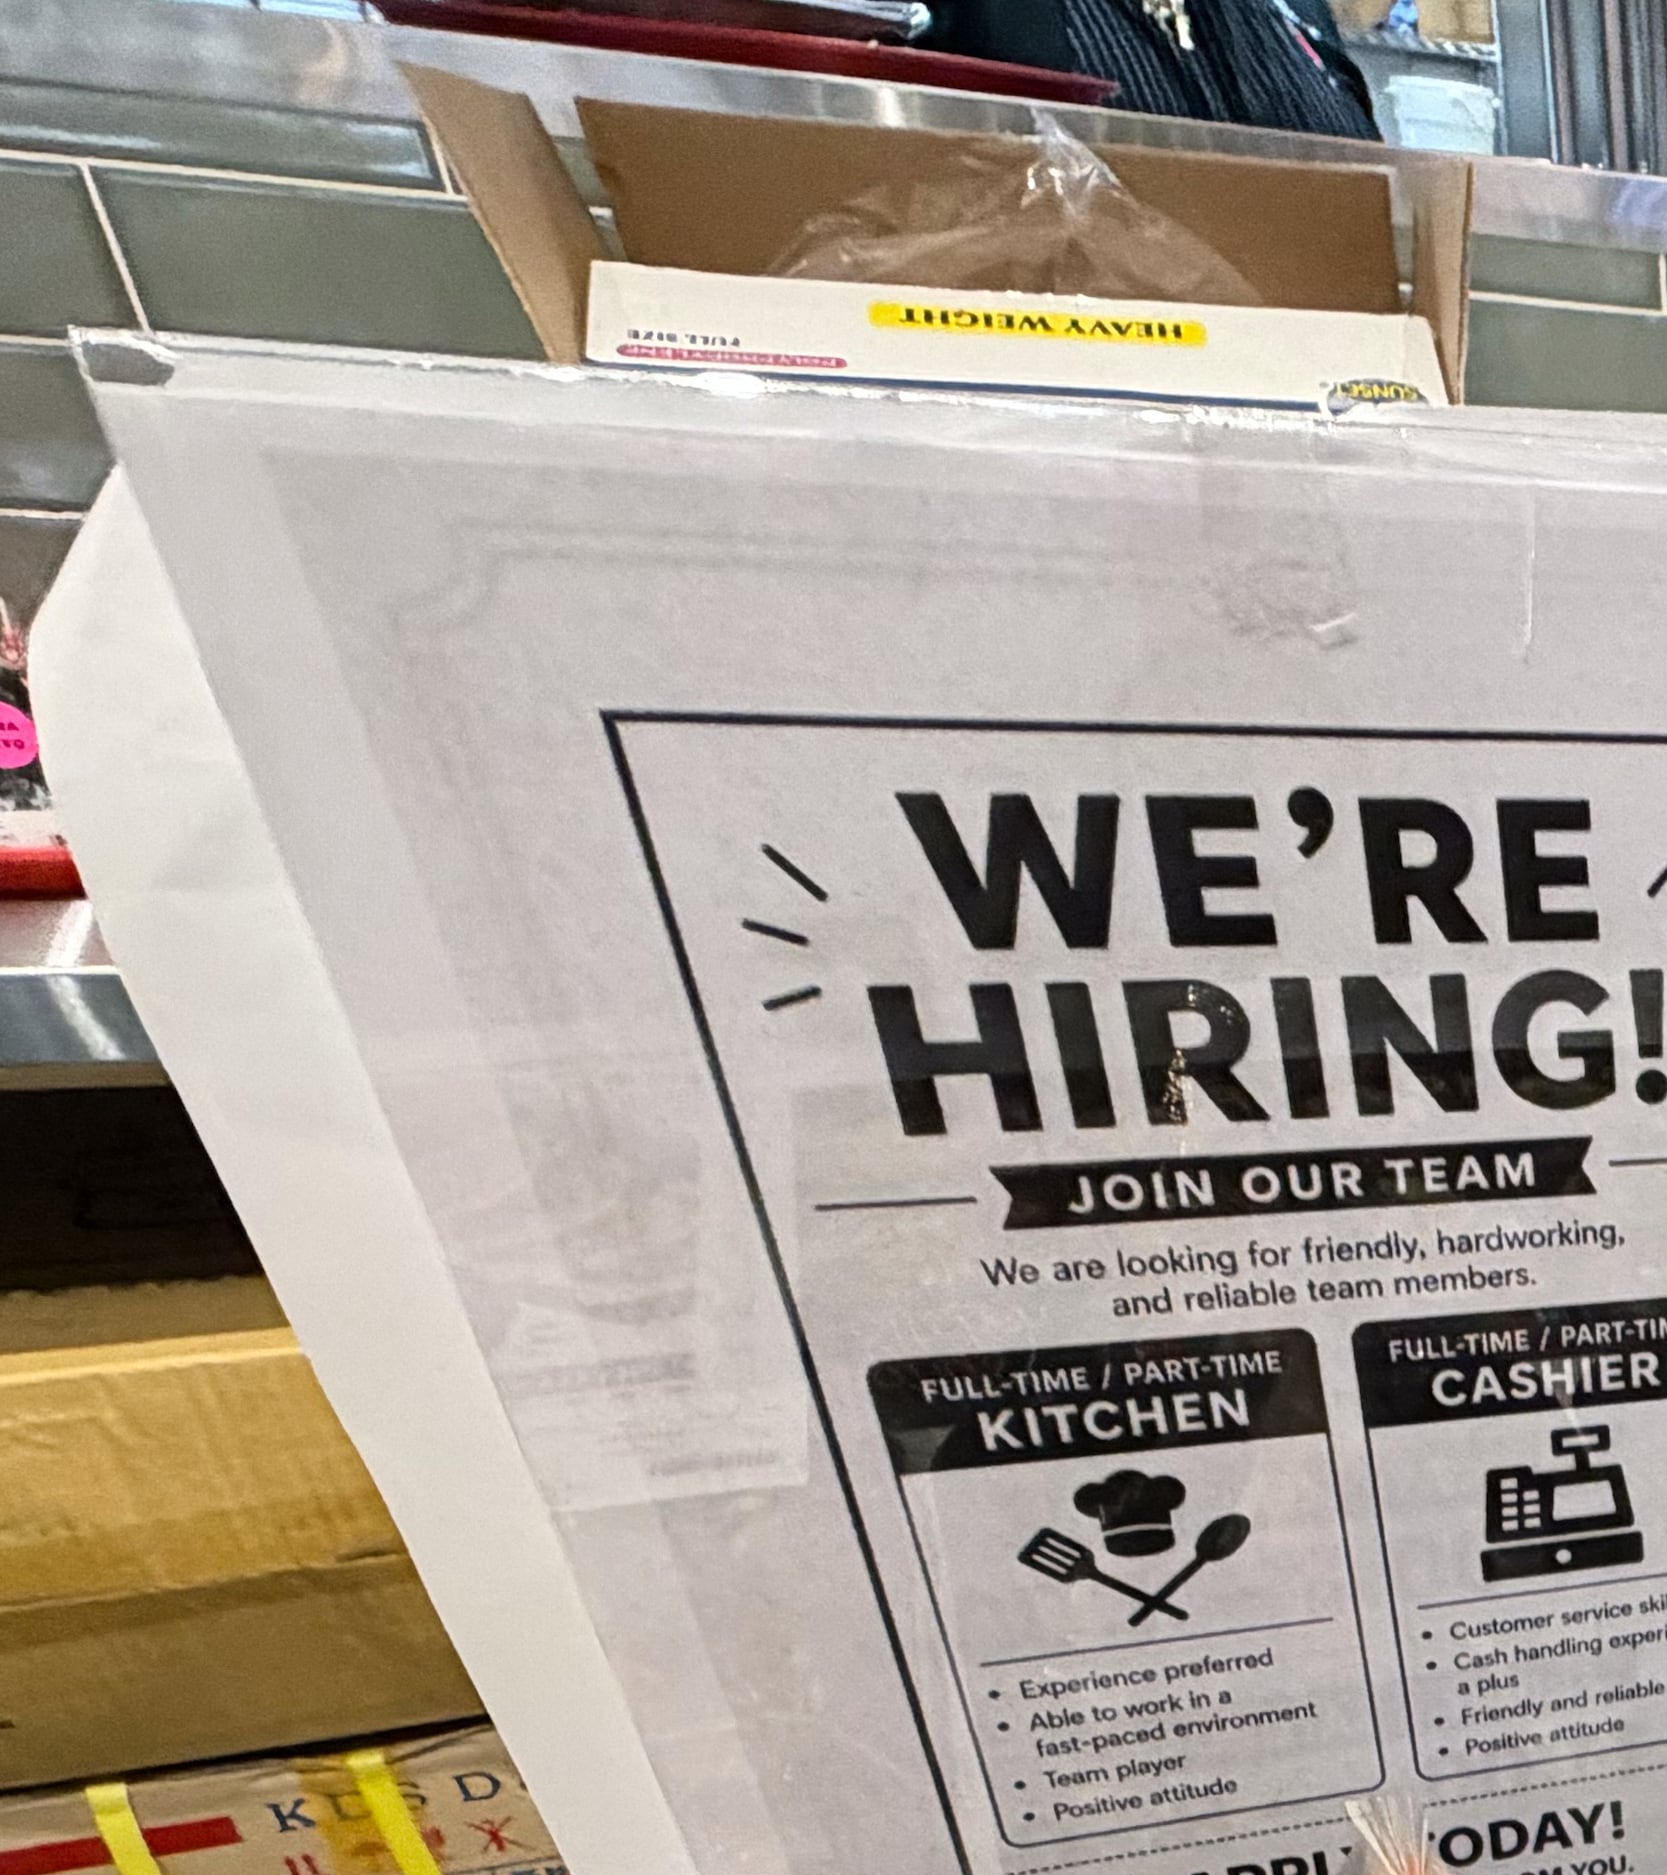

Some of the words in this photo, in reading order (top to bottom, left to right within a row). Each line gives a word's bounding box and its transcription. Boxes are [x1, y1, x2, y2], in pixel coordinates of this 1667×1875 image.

[897, 306, 1054, 333] WEIGHT
[1064, 316, 1184, 341] HEAVY
[895, 785, 1600, 951] WE'RE
[1068, 1168, 1216, 1215] JOIN
[1241, 1162, 1364, 1204] OUR
[1384, 1151, 1536, 1195] TEAM
[979, 1256, 1040, 1287] We
[1053, 1257, 1106, 1284] are
[1116, 1245, 1238, 1278] looking
[1247, 1239, 1292, 1268] for
[1301, 1231, 1427, 1265] friendly,
[1436, 1218, 1626, 1256] hardworking,
[1112, 1286, 1173, 1318] and
[1183, 1279, 1298, 1311] reliable
[1306, 1276, 1385, 1302] team
[1393, 1263, 1537, 1296] members.
[1388, 1328, 1530, 1364] FULL-TIME
[1539, 1326, 1551, 1352] /
[919, 1366, 1091, 1403] FULL-TIME
[1101, 1362, 1112, 1391] /
[1123, 1350, 1283, 1387] PART-TIME
[1431, 1350, 1662, 1408] CASHIER
[976, 1387, 1251, 1452] KITCHEN
[1450, 1612, 1554, 1642] Customer
[1560, 1602, 1633, 1625] service
[1018, 1665, 1157, 1700] Experience
[1164, 1647, 1274, 1685] preferred
[1453, 1649, 1509, 1671] Cash
[1514, 1636, 1603, 1664] handling
[1457, 1680, 1471, 1696] a
[1476, 1672, 1520, 1698] plus
[1460, 1696, 1544, 1726] Friendly
[1550, 1689, 1588, 1712] and
[1595, 1679, 1666, 1707] reliable
[1029, 1707, 1085, 1732] Able
[1091, 1706, 1118, 1723] to
[1124, 1693, 1183, 1719] work
[1189, 1690, 1211, 1710] in
[1218, 1689, 1233, 1705] a
[1035, 1722, 1166, 1759] fast-paced
[1172, 1701, 1319, 1738] environment
[1464, 1728, 1543, 1757] Positive
[1548, 1716, 1625, 1743] attitude
[1042, 1767, 1109, 1790] Team
[1116, 1753, 1187, 1783] player
[1052, 1792, 1143, 1822] Positive
[1149, 1776, 1238, 1807] attitude
[1427, 1800, 1626, 1869] ODAY!
